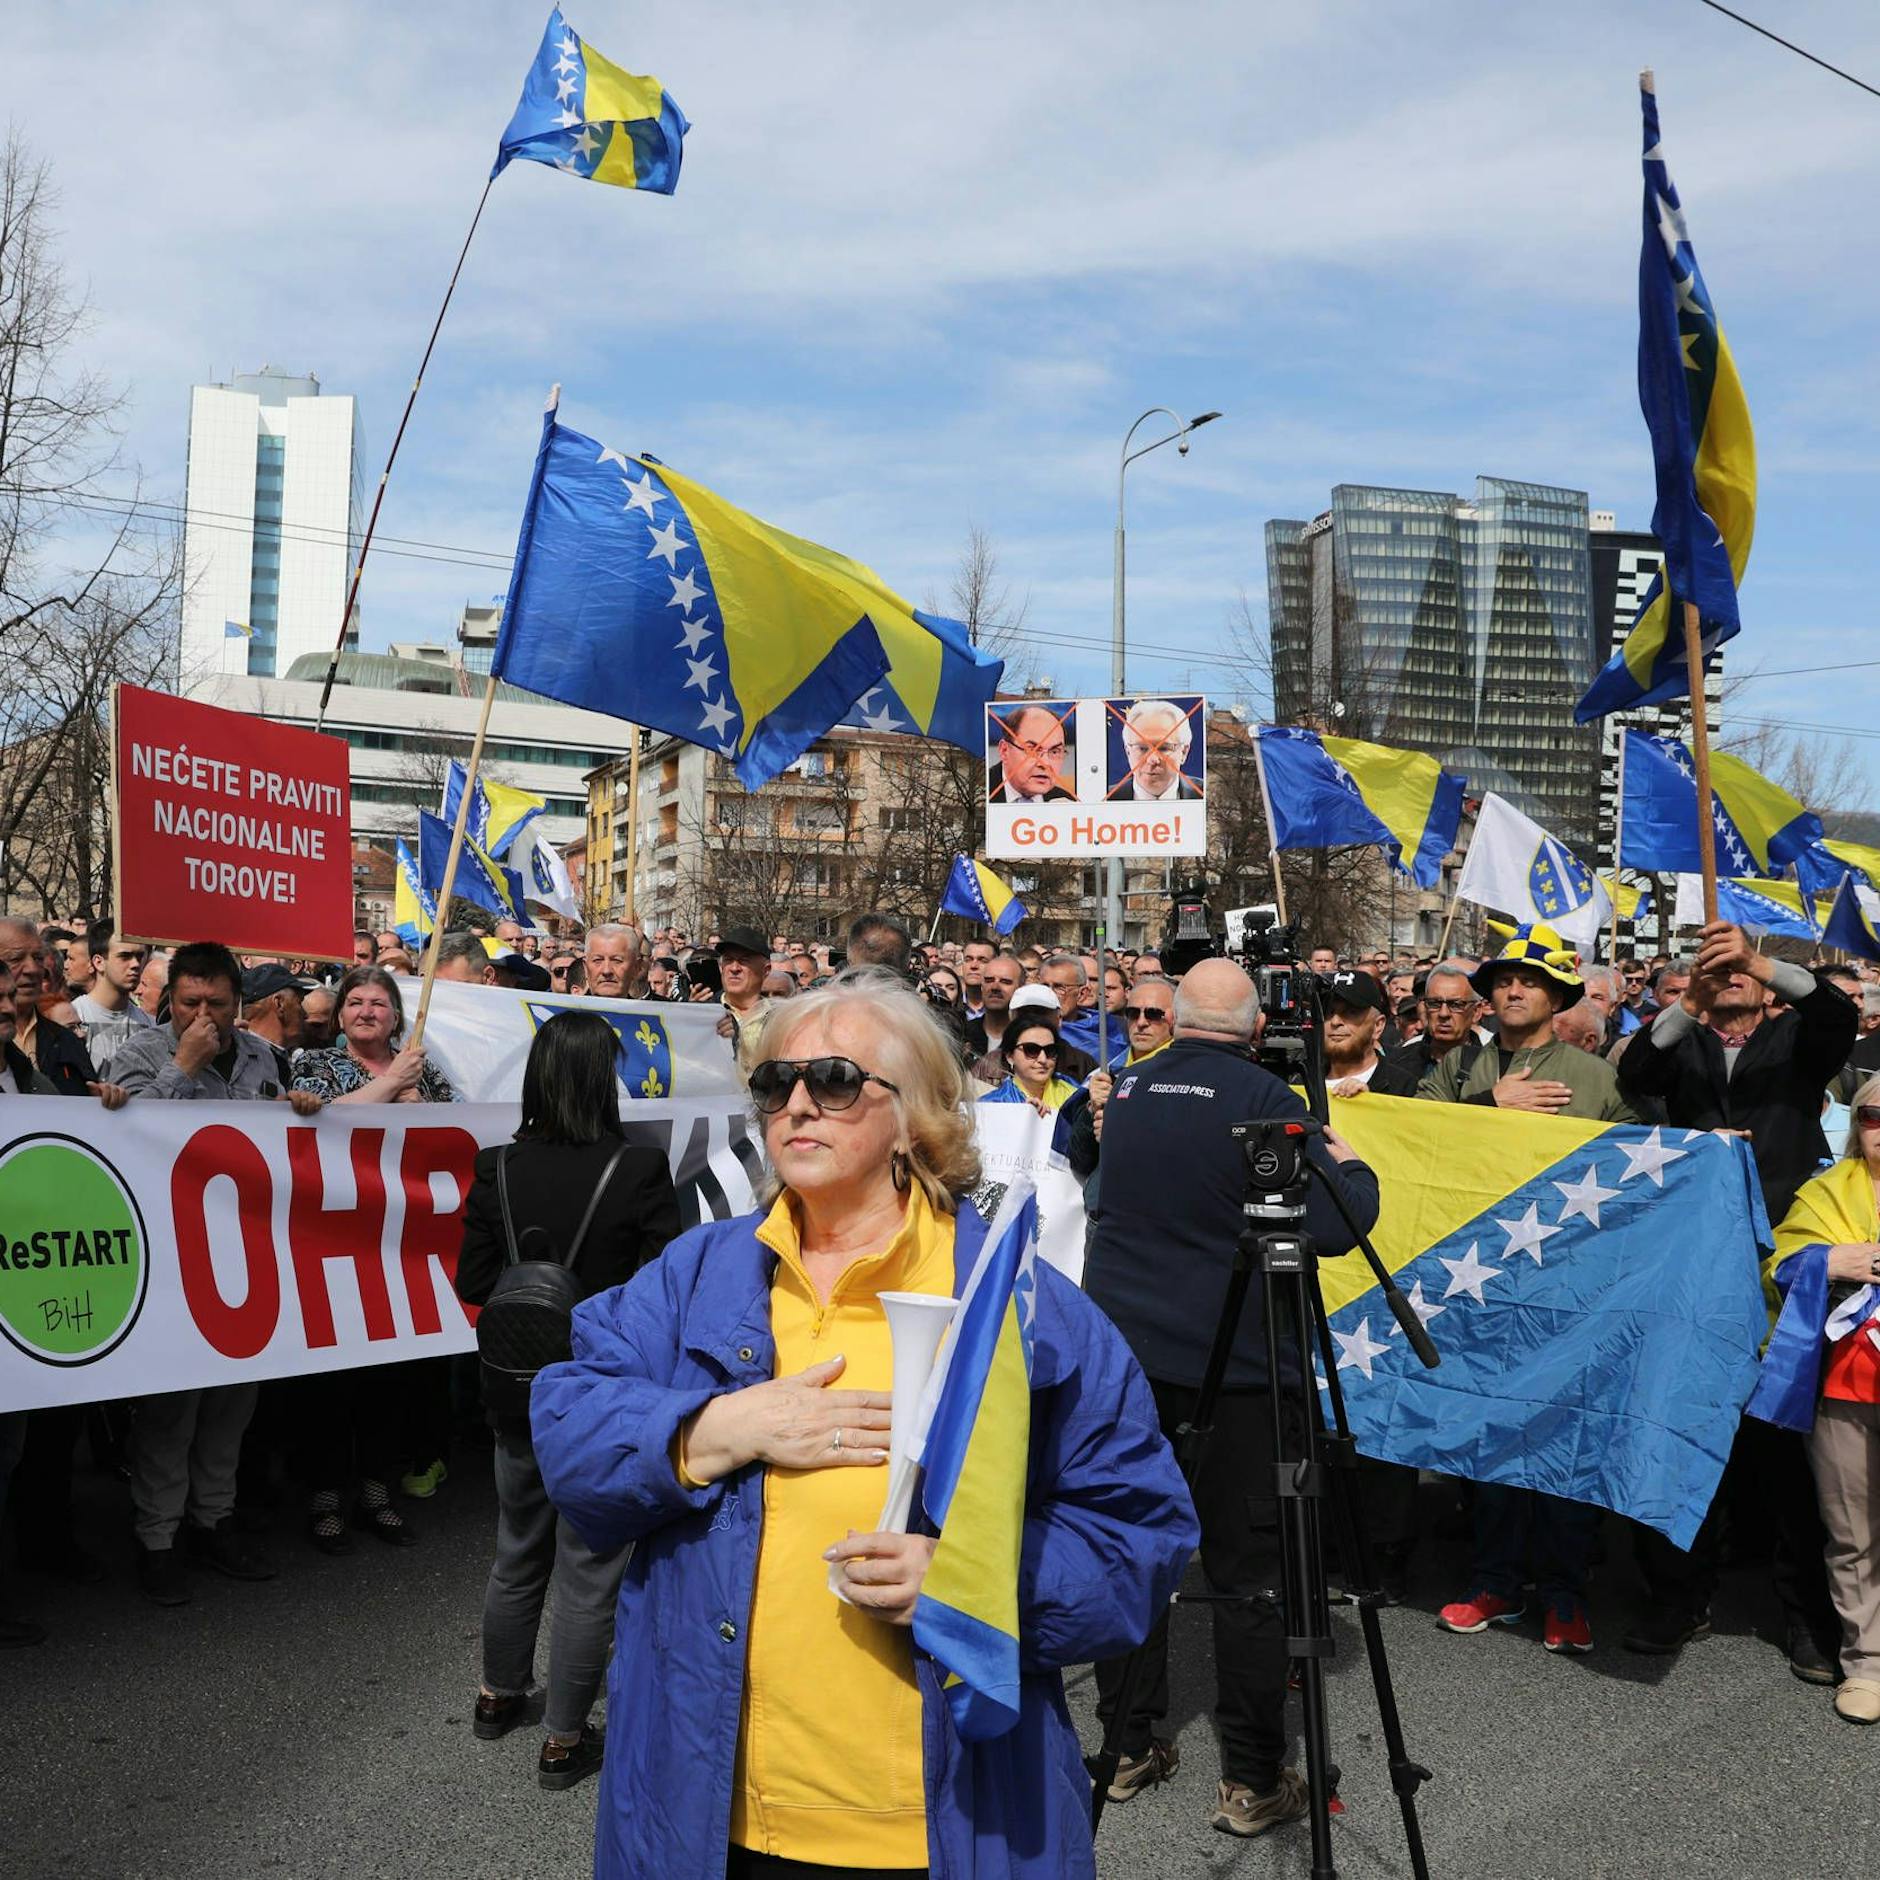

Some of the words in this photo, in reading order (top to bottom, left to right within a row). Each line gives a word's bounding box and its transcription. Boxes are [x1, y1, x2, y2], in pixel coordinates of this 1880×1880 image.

[249, 768, 342, 817] PRAVITI
[154, 799, 326, 861] NACIONALNE
[1010, 817, 1059, 846] Go
[1071, 815, 1182, 845] Home!
[184, 856, 296, 904] TOROVE!
[1148, 1083, 1191, 1095] ASSOCIATED
[1189, 1085, 1216, 1098] PRESS
[171, 1124, 484, 1359] OHR
[38, 1289, 93, 1333] BiH
